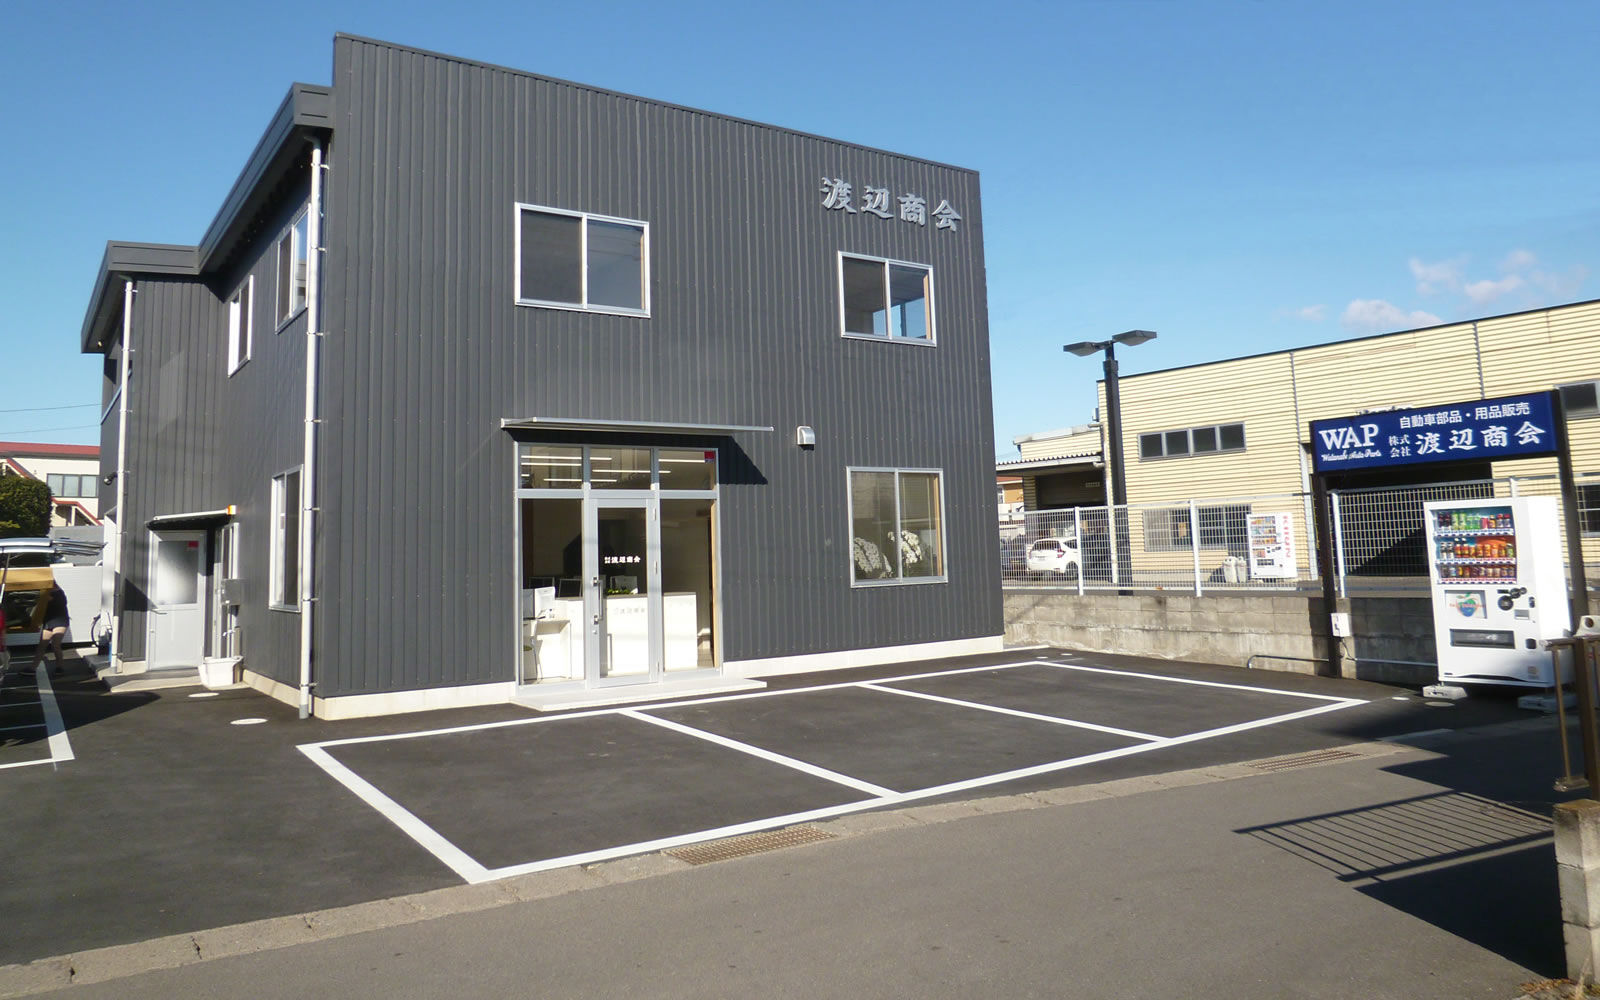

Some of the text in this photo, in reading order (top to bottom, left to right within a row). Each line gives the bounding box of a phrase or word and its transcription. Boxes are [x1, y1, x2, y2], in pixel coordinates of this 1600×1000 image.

[820, 176, 962, 233] 渡辺商会
[1400, 402, 1530, 429] 自動車部品・用品販売
[1318, 423, 1379, 450] WAP
[1388, 434, 1410, 447] 株式
[1415, 421, 1546, 455] 渡辺商会
[1390, 446, 1412, 458] 会社
